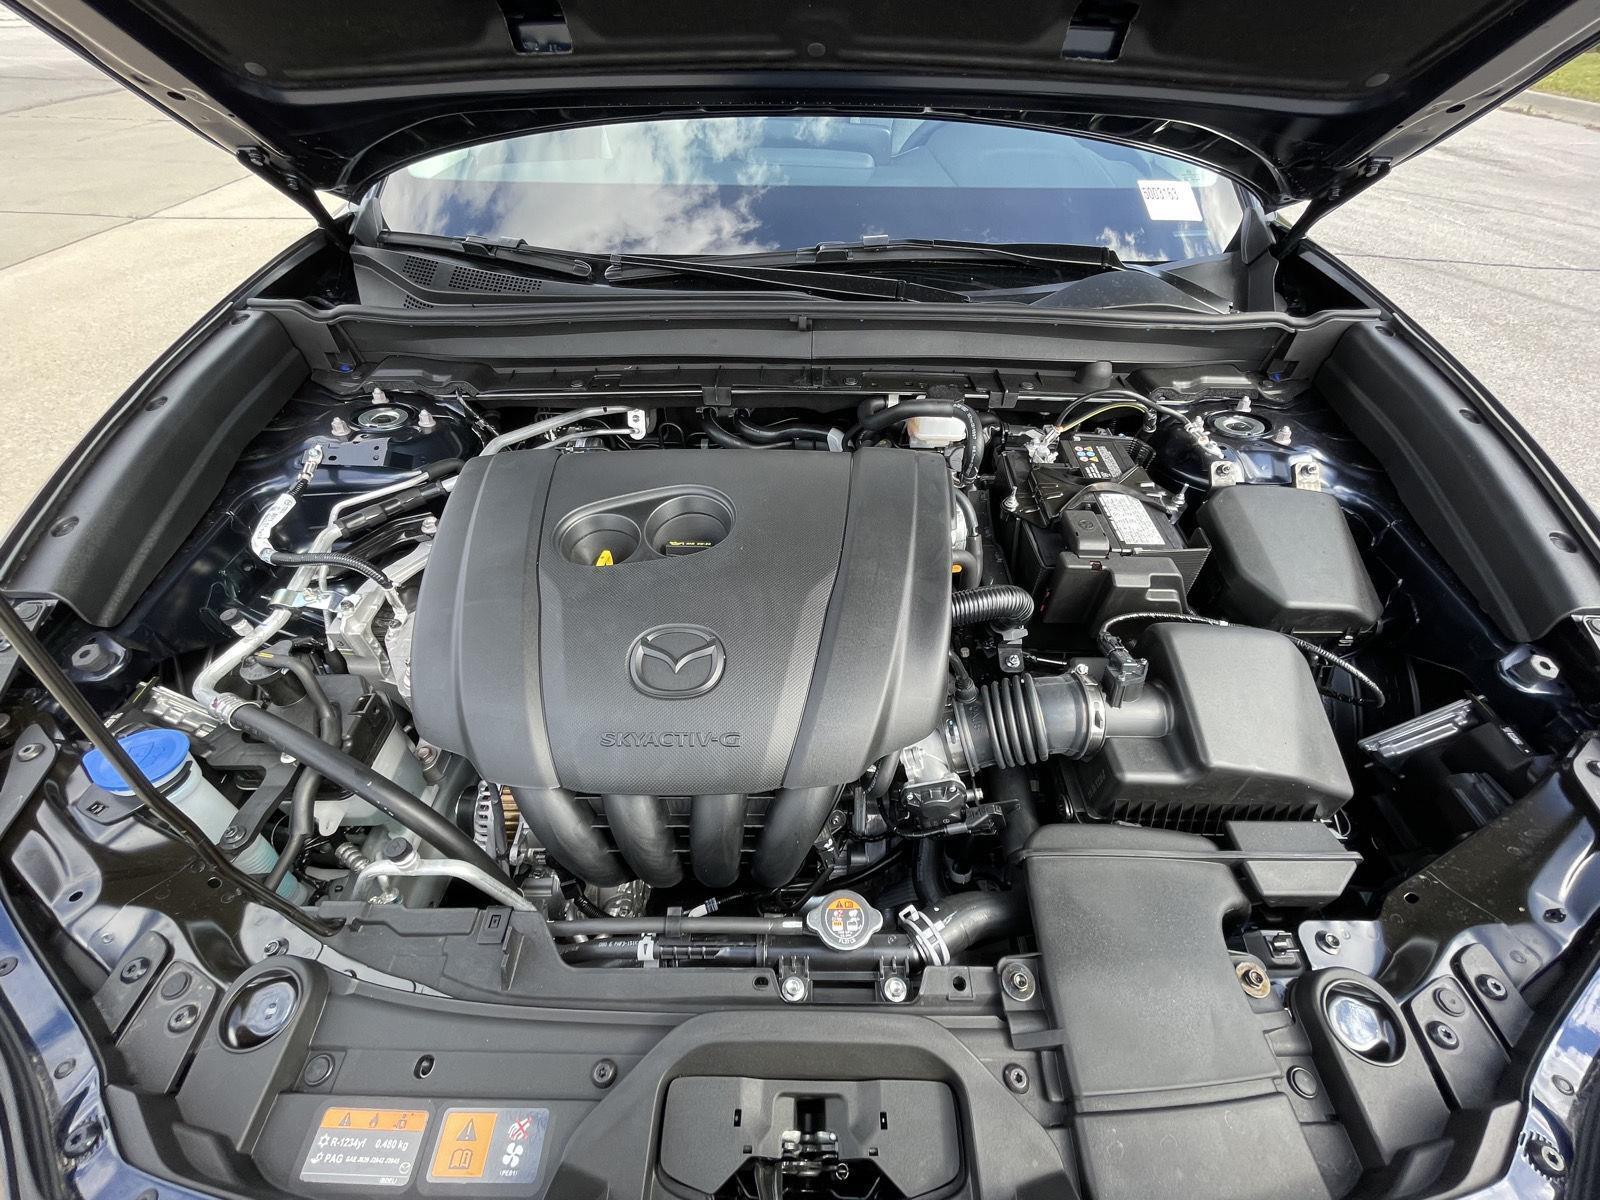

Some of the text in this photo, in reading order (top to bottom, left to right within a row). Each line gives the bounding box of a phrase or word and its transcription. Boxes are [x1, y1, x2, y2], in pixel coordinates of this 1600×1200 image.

[600, 731, 742, 748] SKYACTIV-G
[330, 1137, 367, 1150] R-1234yf
[398, 1139, 409, 1152] kg
[324, 1154, 343, 1164] PAG
